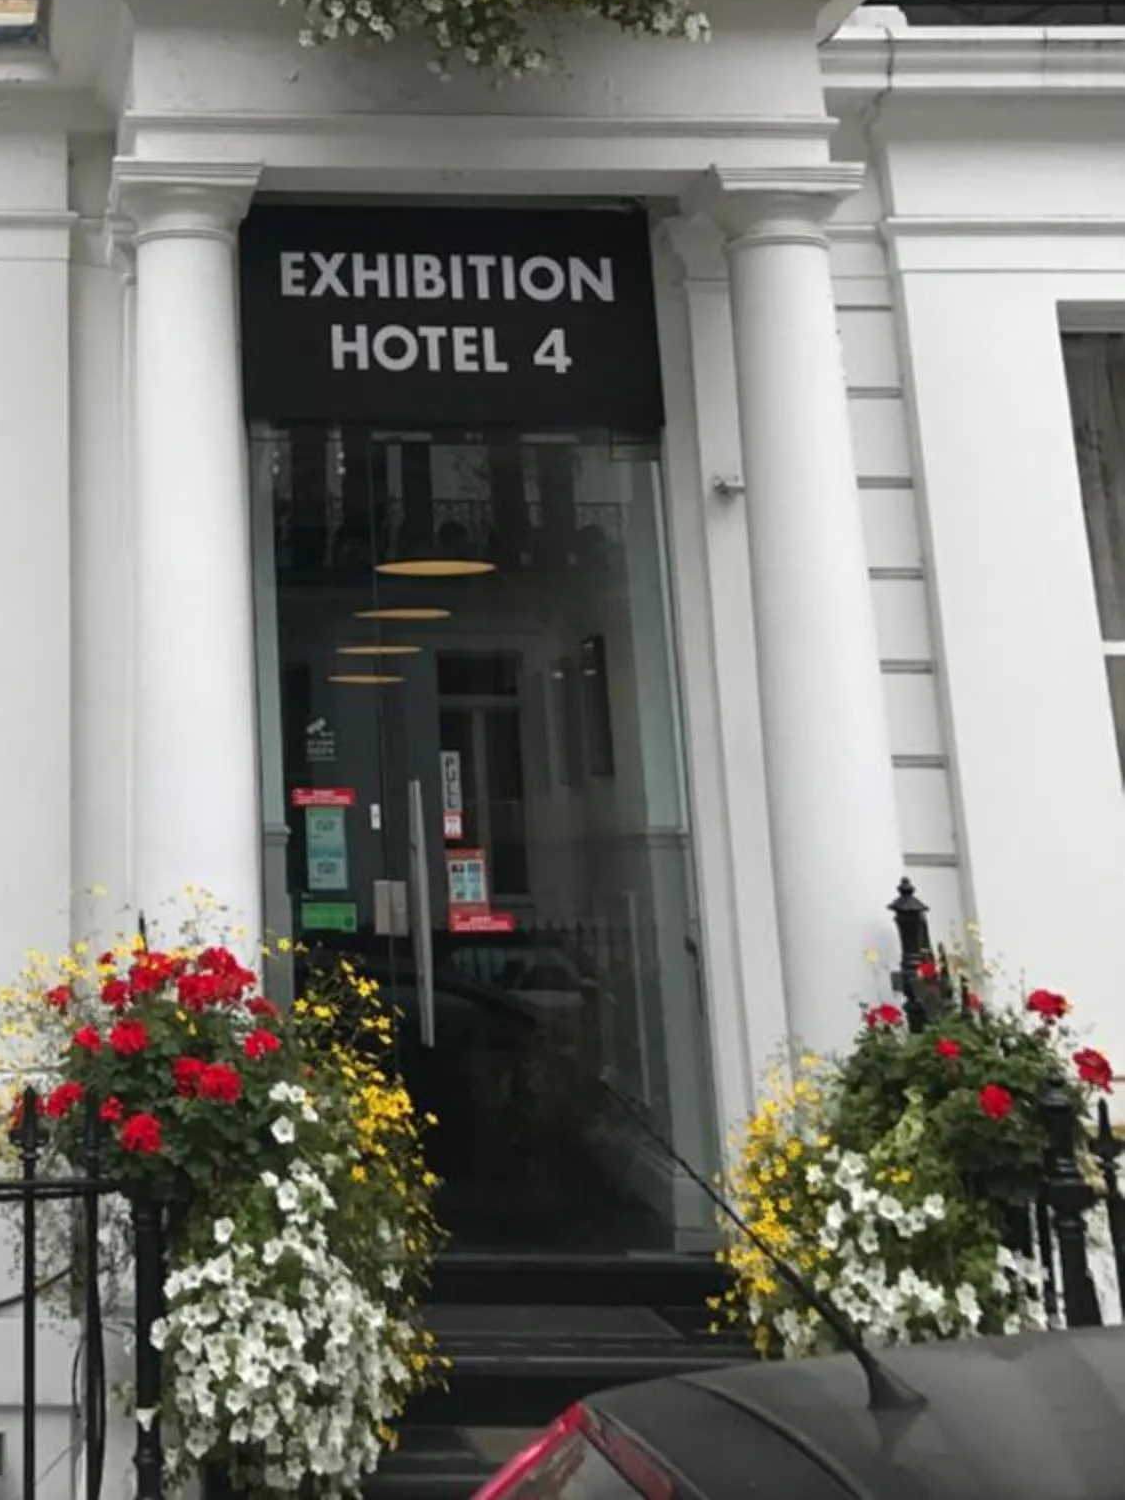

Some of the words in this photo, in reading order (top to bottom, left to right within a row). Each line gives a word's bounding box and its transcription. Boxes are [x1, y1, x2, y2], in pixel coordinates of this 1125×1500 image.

[280, 251, 614, 302] EXHIBITION
[331, 324, 508, 372] HOTEL
[533, 328, 572, 373] 4
